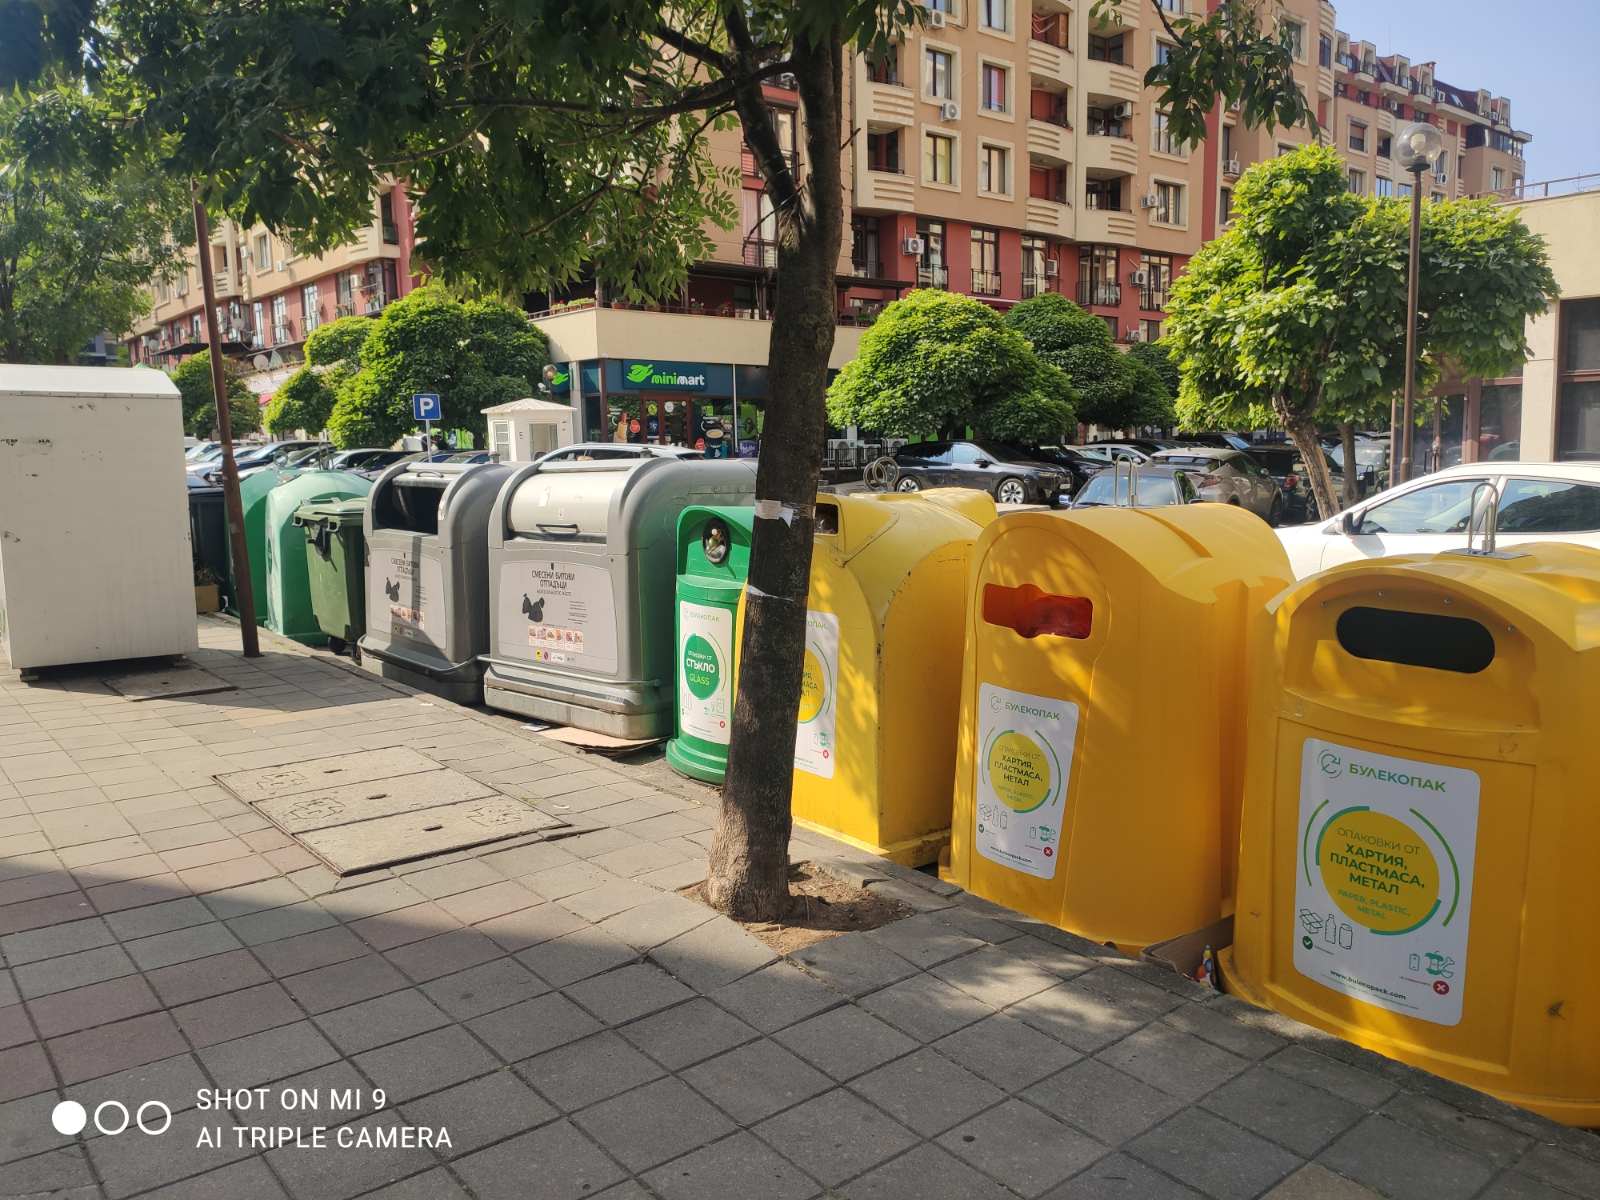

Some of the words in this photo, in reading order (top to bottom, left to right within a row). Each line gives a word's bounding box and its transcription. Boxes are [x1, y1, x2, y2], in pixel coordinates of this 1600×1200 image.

[651, 371, 705, 386] minimart
[419, 397, 434, 417] P
[686, 658, 716, 674] СТЪКЛО
[689, 673, 711, 686] GLASS
[1005, 702, 1060, 721] БУЛЕКОПАК
[994, 761, 1043, 782] ПЛАСТМАСА,
[1002, 754, 1034, 770] ХАРТИЯ,
[1349, 763, 1447, 793] БУЛЕКОПАК
[1337, 827, 1400, 850] ОПАКОВКИ
[1404, 844, 1421, 855] ОТ
[1345, 843, 1408, 870] ХАРТИЯ,
[1330, 852, 1425, 888] ПЛАСТМАСА,
[1349, 873, 1400, 895] МЕТАЛ
